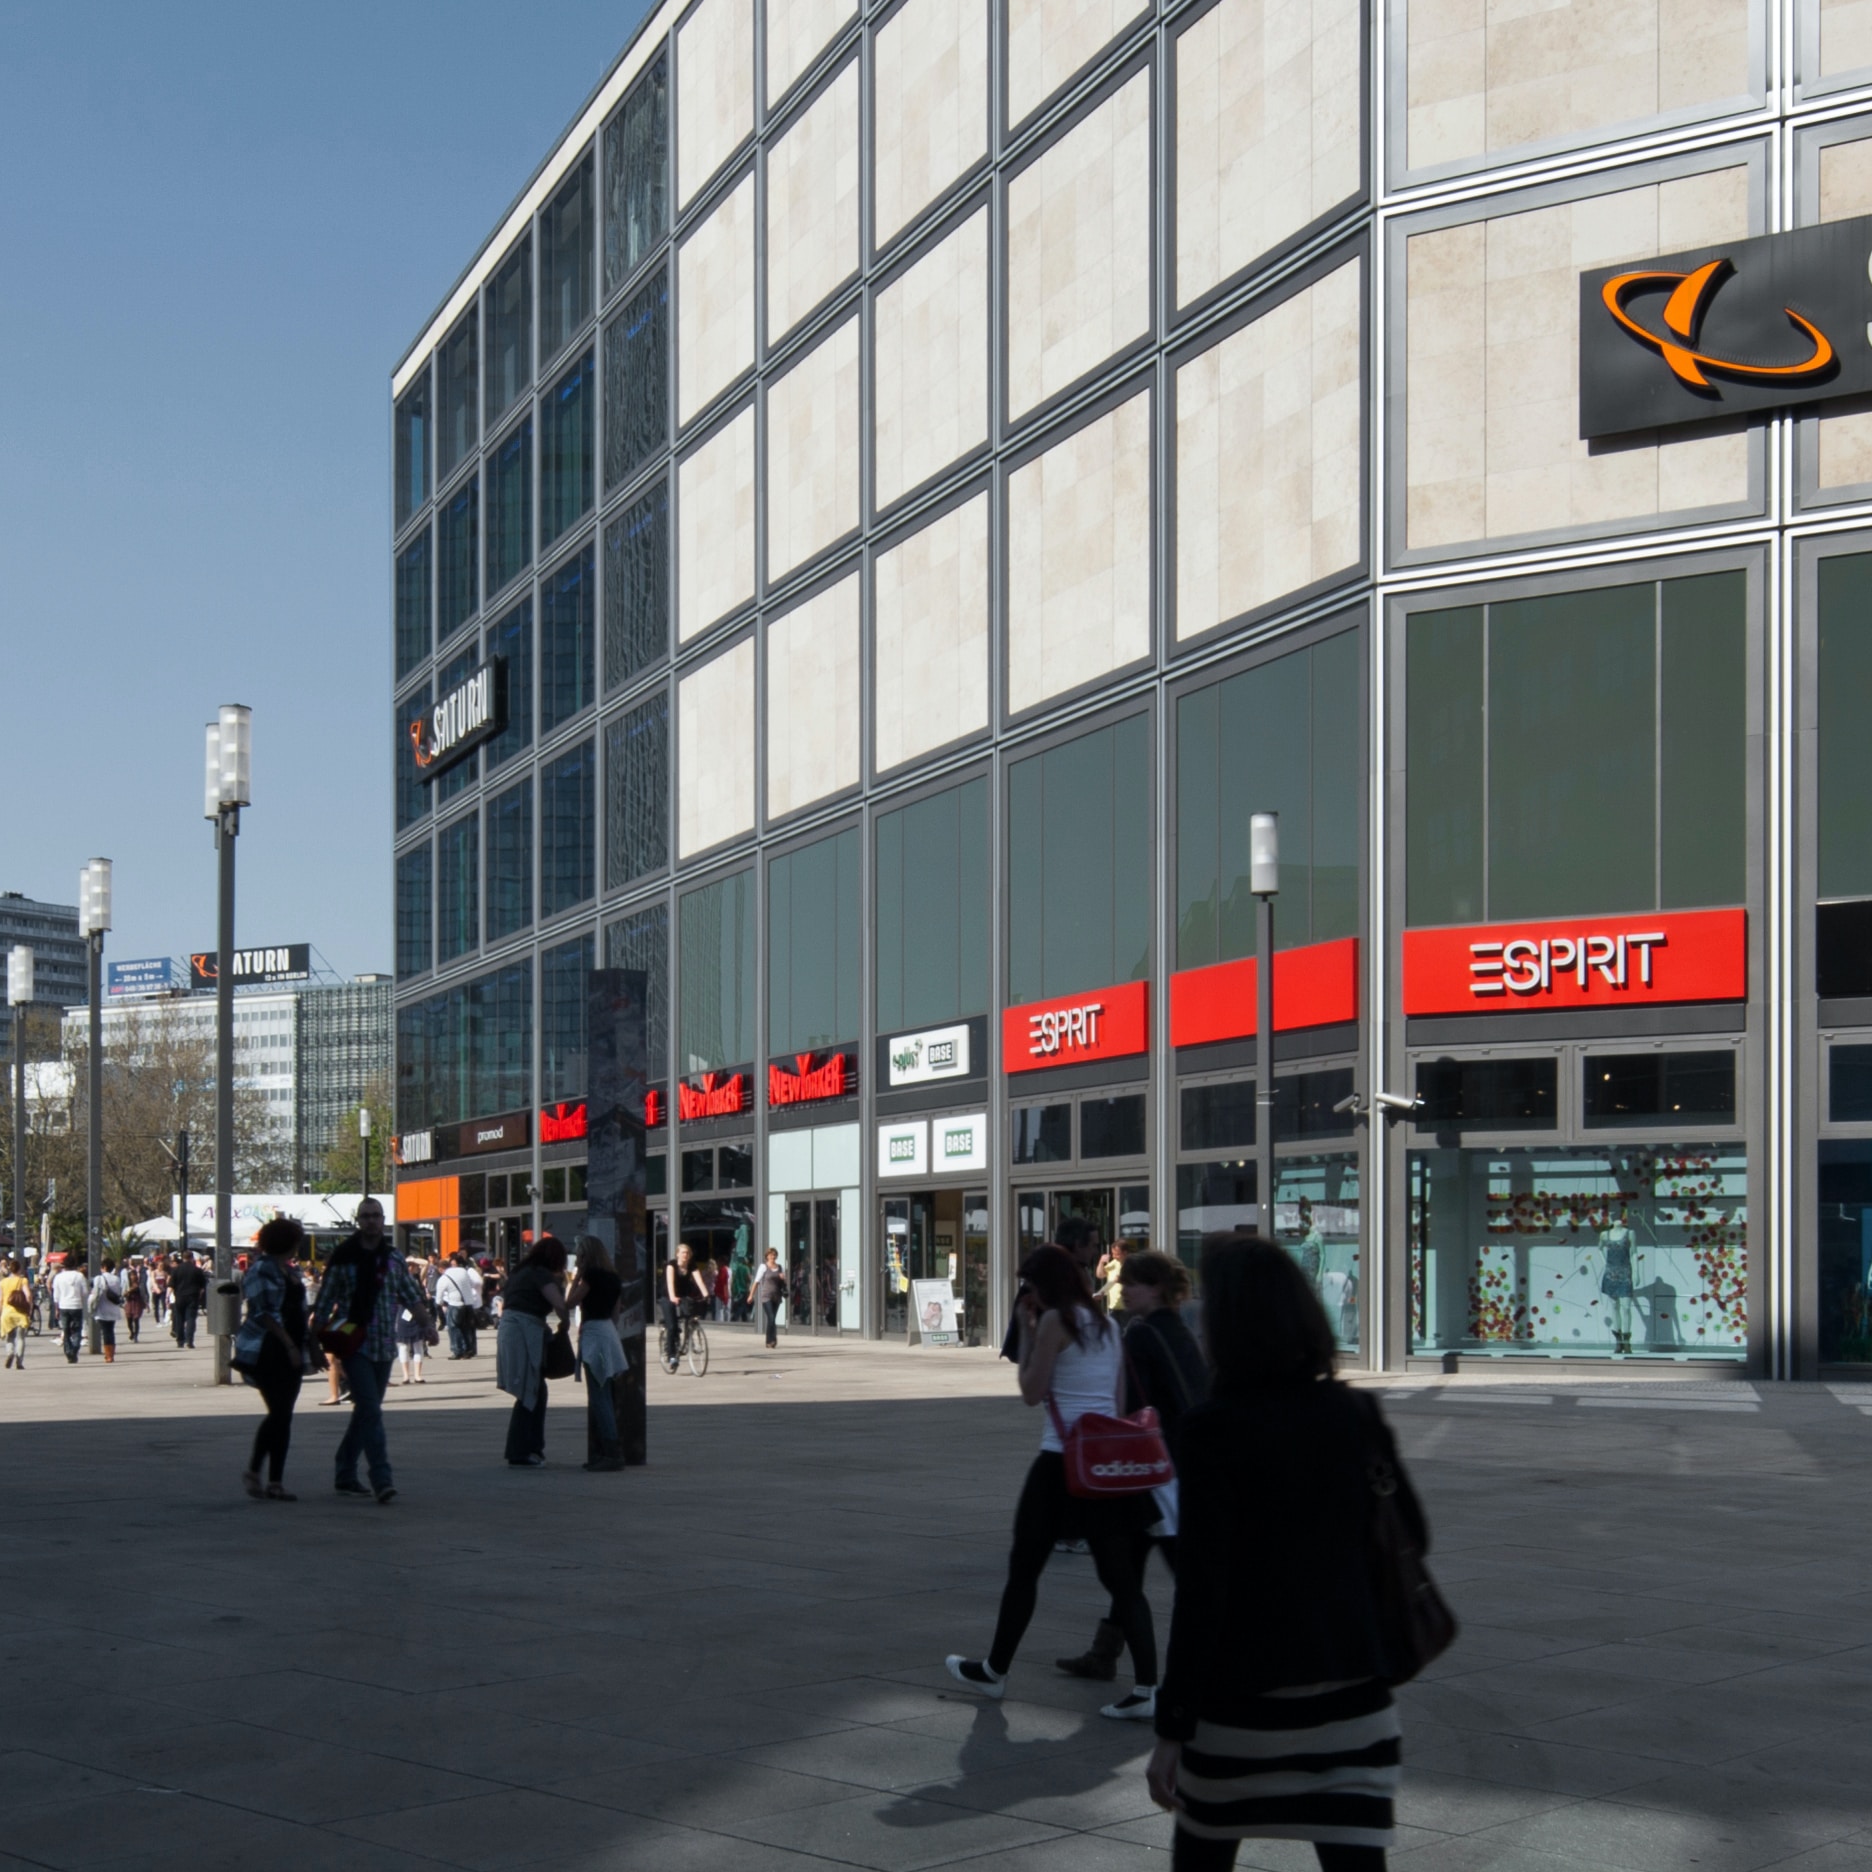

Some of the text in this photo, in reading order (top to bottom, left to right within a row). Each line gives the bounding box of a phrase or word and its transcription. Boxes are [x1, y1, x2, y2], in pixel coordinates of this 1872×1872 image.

[432, 668, 489, 757] SATURN
[233, 948, 289, 975] ATURN
[1470, 932, 1665, 992] ESPRIT
[1029, 1003, 1101, 1054] ESPRIT
[929, 1042, 953, 1064] BASE
[477, 1126, 504, 1144] promod
[946, 1132, 972, 1154] BASE
[403, 1131, 431, 1164] SATURN
[890, 1139, 914, 1159] BASE
[1091, 1460, 1152, 1476] adidas
